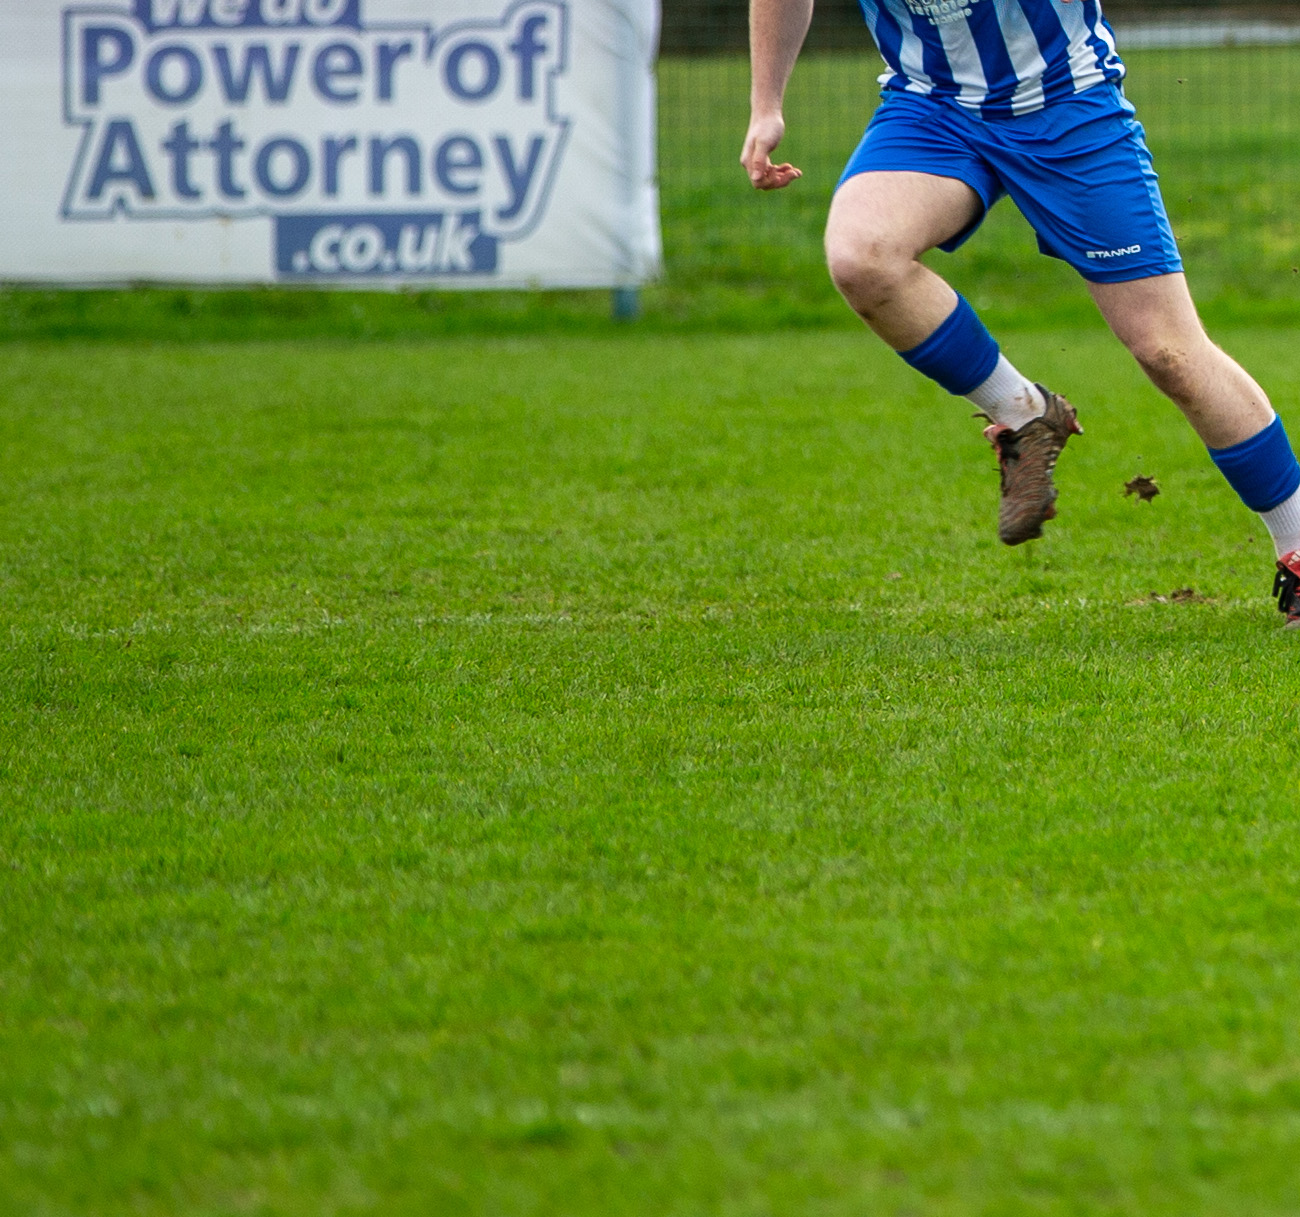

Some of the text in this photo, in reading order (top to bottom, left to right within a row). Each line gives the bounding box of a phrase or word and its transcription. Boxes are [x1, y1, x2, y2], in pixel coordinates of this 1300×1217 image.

[82, 14, 548, 106] Power of
[86, 118, 547, 220] Attorney
[291, 211, 478, 275] .co.uk
[1086, 244, 1141, 259] STANNO
